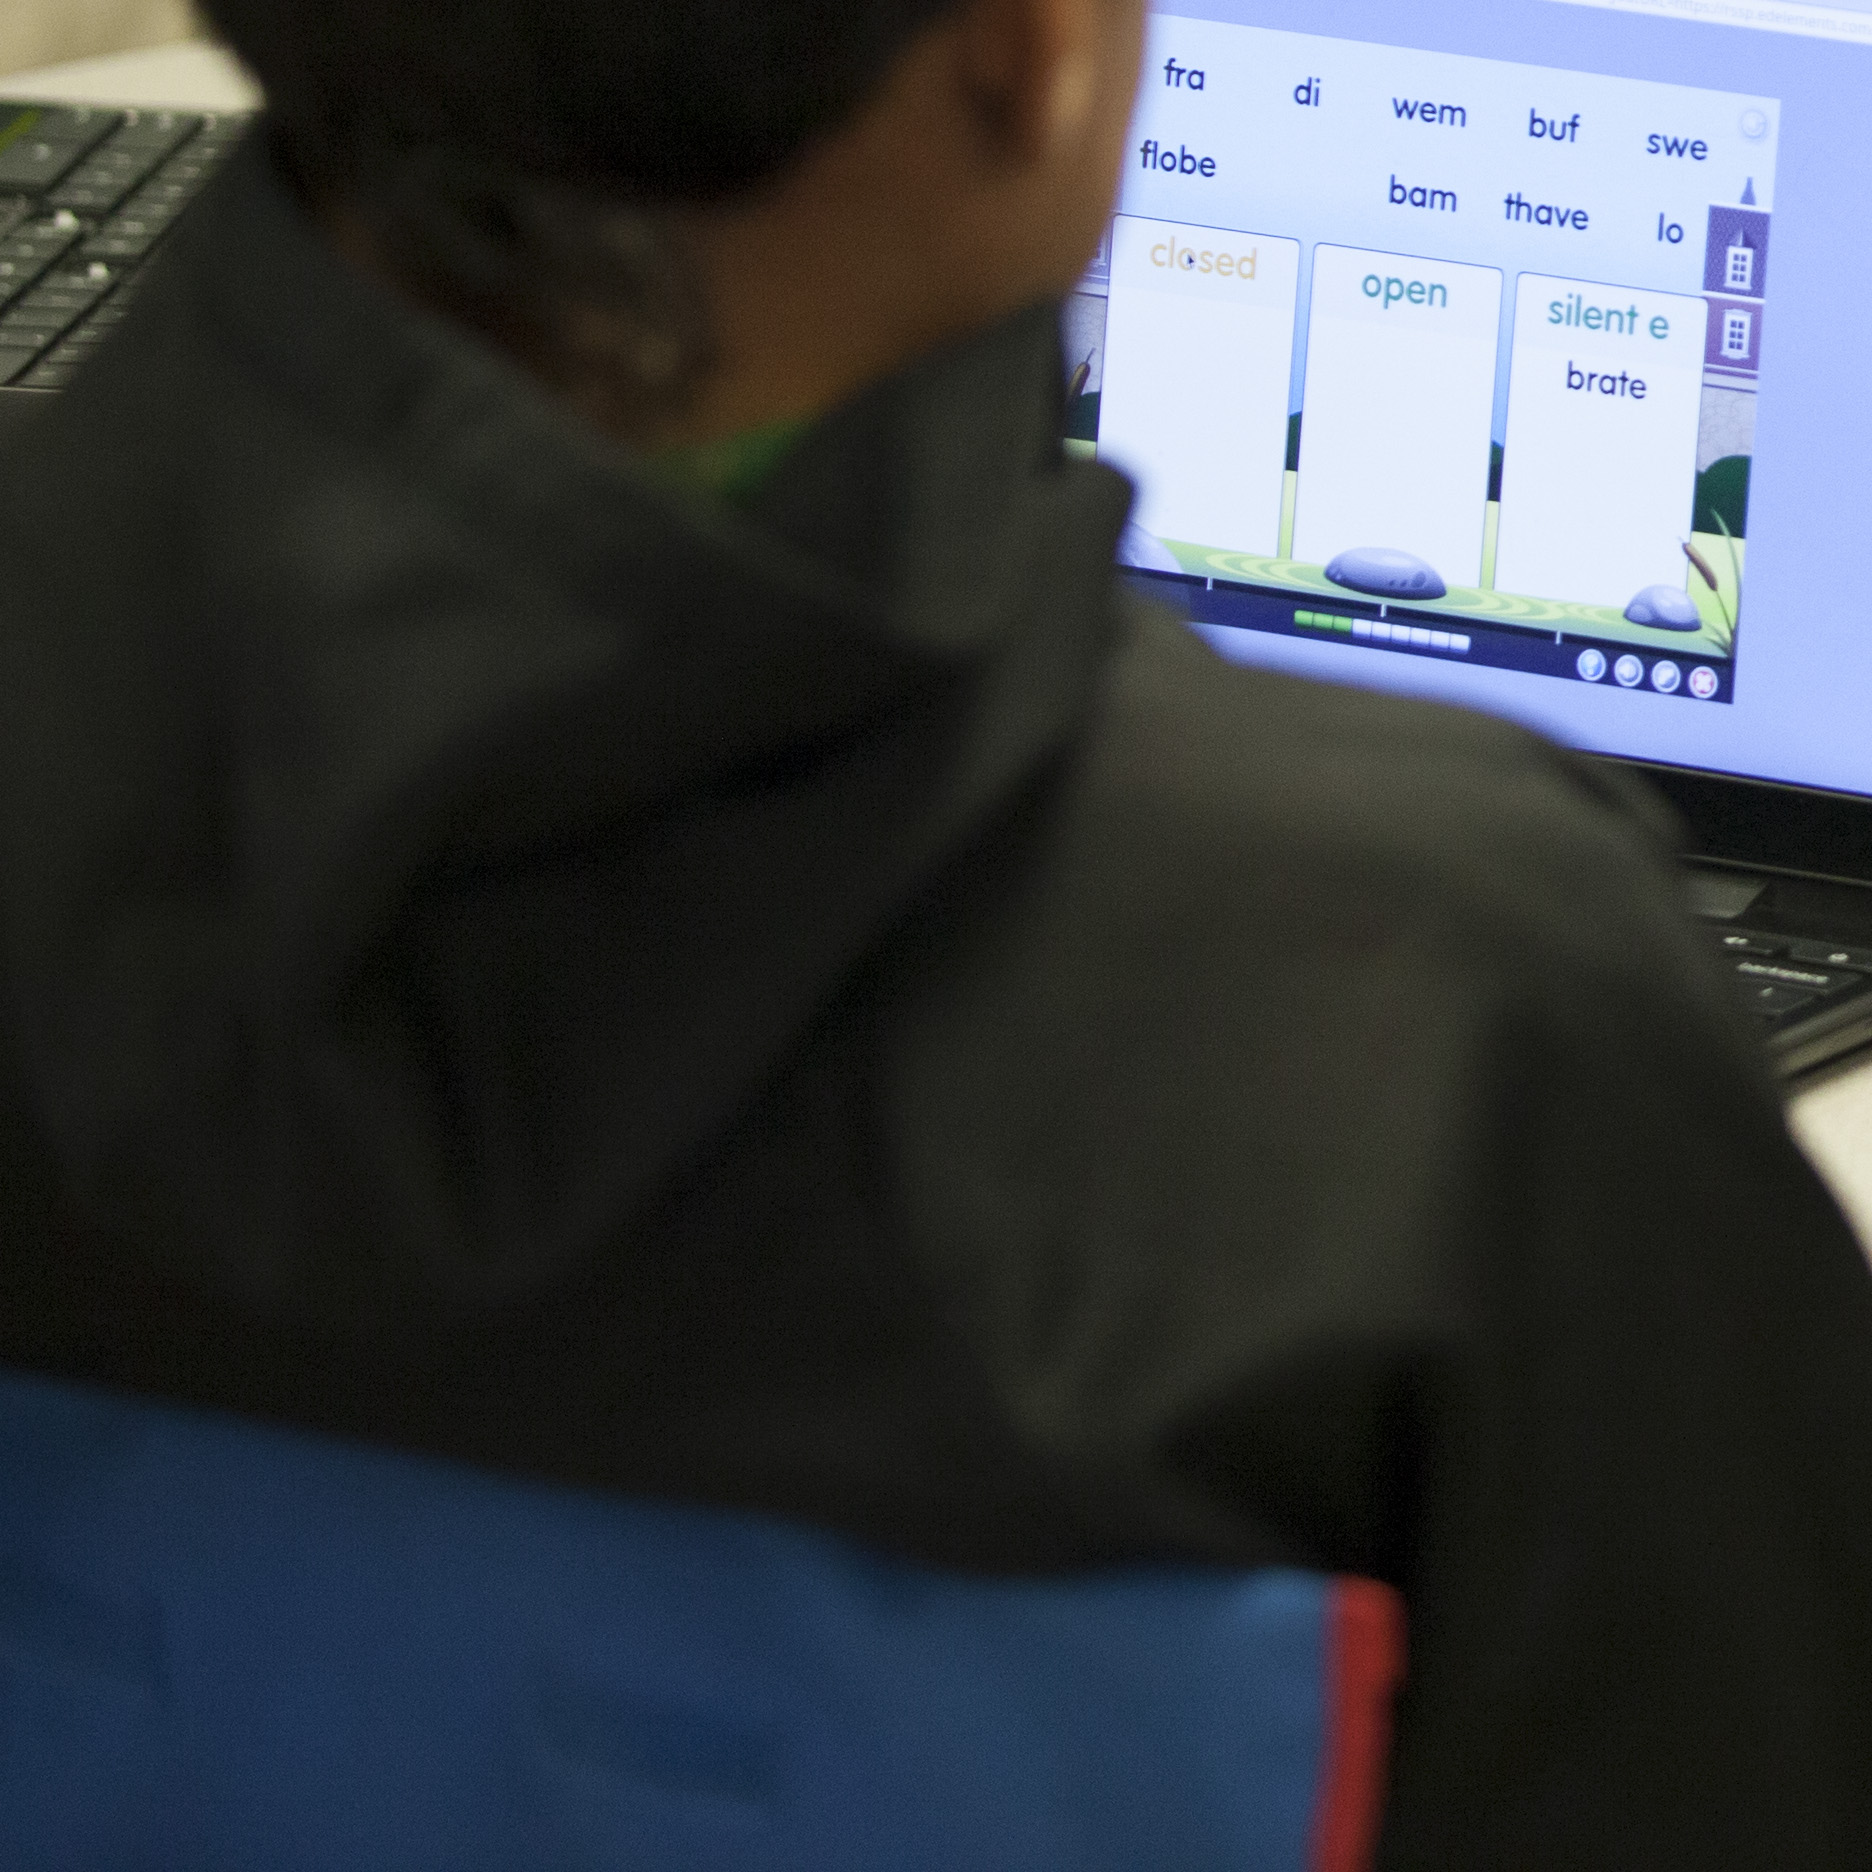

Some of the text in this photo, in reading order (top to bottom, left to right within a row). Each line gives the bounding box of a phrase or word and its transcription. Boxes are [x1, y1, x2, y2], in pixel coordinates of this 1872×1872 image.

[1162, 56, 1710, 163] fra di wem buf swe
[1138, 138, 1686, 246] flobe bam thave lo
[1150, 239, 1257, 281] closed
[1360, 272, 1449, 311] open
[1547, 292, 1671, 341] silent e
[1565, 359, 1648, 401] brate
